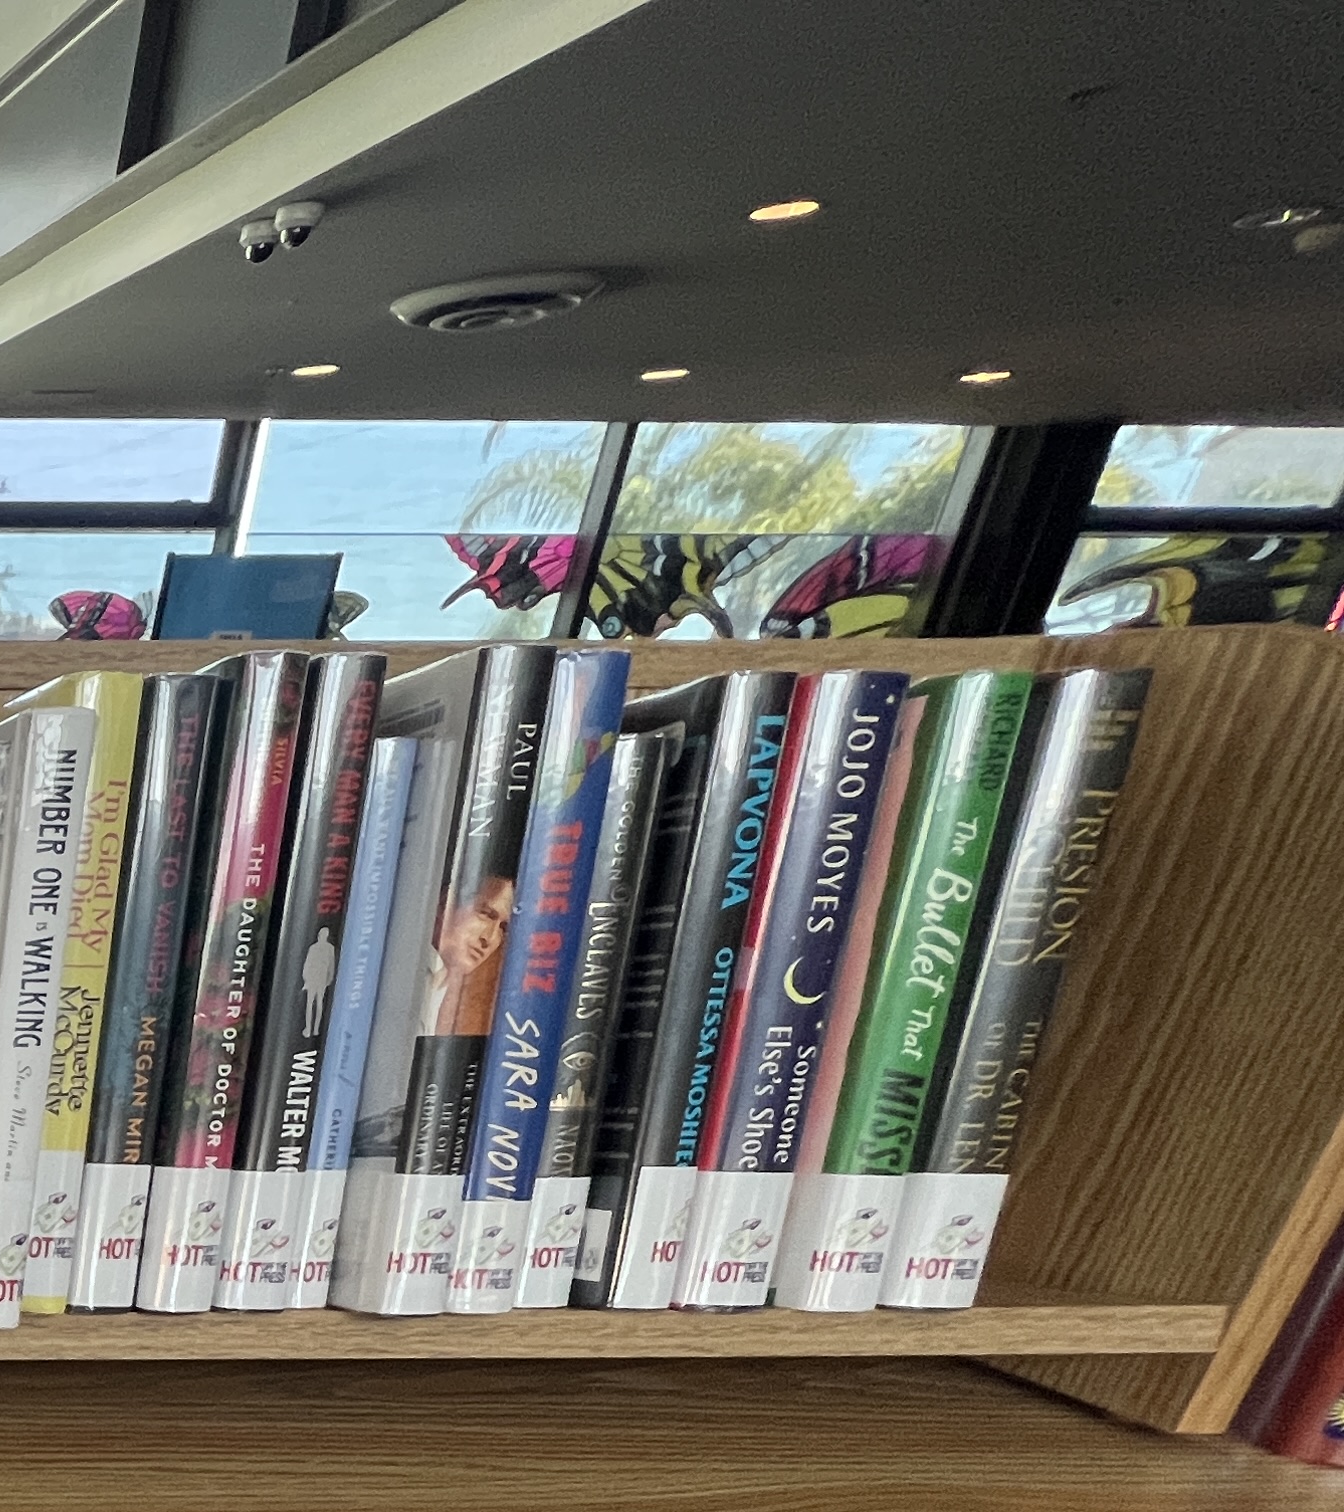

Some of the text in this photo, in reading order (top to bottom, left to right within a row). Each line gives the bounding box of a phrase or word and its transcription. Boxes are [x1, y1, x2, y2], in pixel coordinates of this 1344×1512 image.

[506, 723, 536, 800] PAUL
[724, 715, 786, 908] LAPVONA
[807, 709, 879, 933] JOJO MOYES
[13, 751, 76, 1049] NUMBER ONE WALKING
[208, 845, 264, 1147] THE DAUGHTER OF DOCTOR
[697, 948, 733, 1054] OTTESSA
[900, 869, 972, 1057] Bullet That
[45, 986, 100, 1116] Jennette McCurdy
[131, 1015, 156, 1107] MEGAN
[280, 1052, 316, 1137] WALTER
[505, 1012, 542, 1112] SARA
[772, 1045, 816, 1163] Someone
[388, 1251, 432, 1275] HOT
[907, 1258, 954, 1280] HOT
